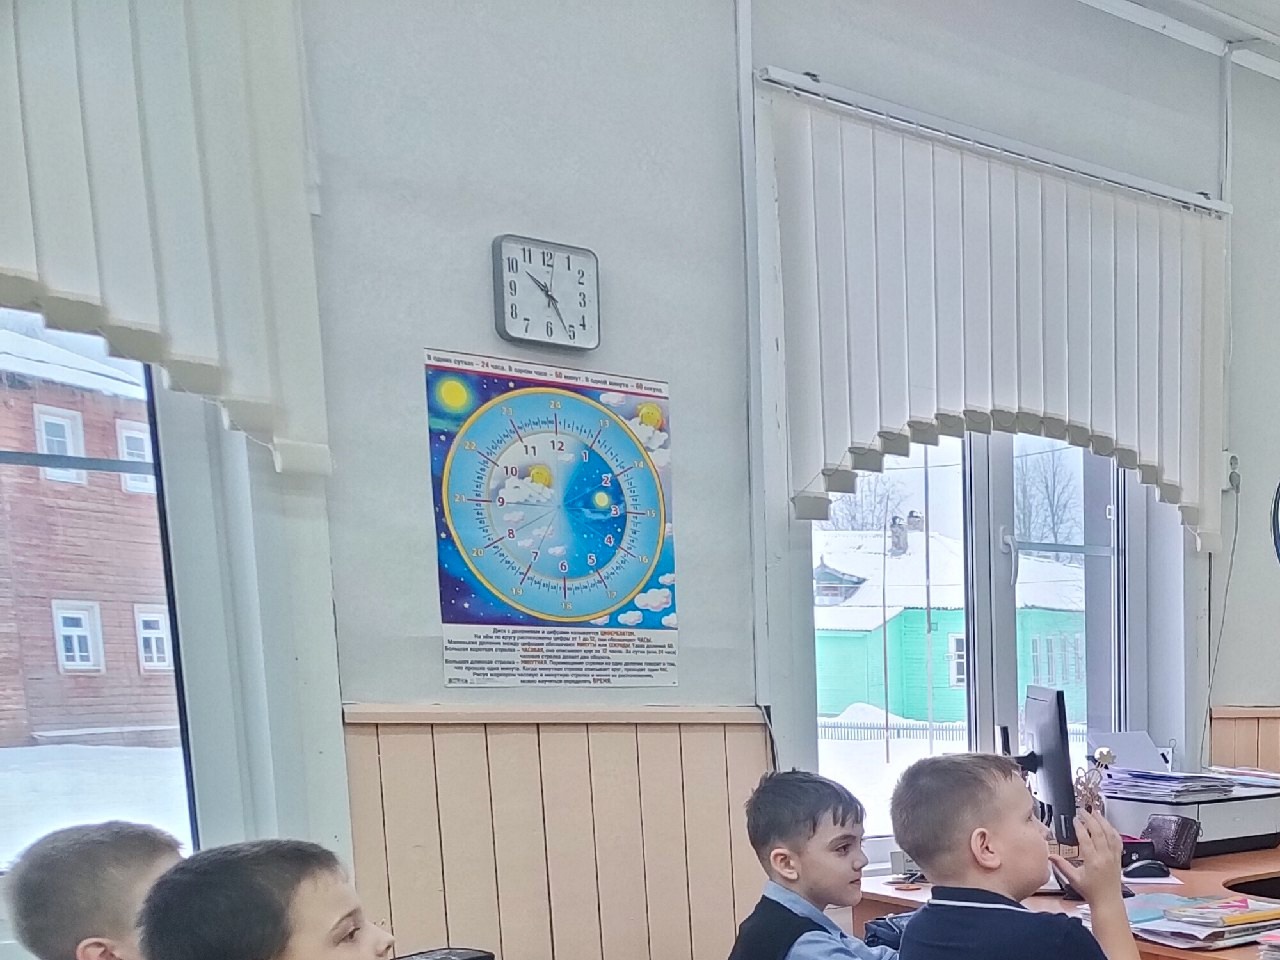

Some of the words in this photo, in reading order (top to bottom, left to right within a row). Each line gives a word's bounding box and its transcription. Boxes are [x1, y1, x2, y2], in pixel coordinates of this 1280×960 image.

[521, 247, 532, 265] 11
[540, 250, 553, 268] 12
[566, 255, 571, 271] 1
[507, 256, 518, 273] 10
[577, 269, 585, 285] 2
[509, 280, 517, 297] 9
[578, 292, 586, 308] 3
[510, 303, 518, 319] 8
[523, 317, 530, 333] 7
[546, 320, 553, 338] 6
[579, 315, 586, 331] 4
[568, 324, 576, 340] 5
[524, 445, 537, 457] 11
[550, 440, 565, 452] 12
[582, 451, 587, 461] 1
[503, 466, 518, 477] 10
[602, 475, 611, 485] 2
[497, 497, 505, 507] 9
[611, 506, 619, 516] 3
[507, 529, 515, 539] 8
[605, 536, 613, 545] 4
[531, 551, 539, 561] 7
[588, 555, 596, 564] 5
[560, 561, 567, 571] 6
